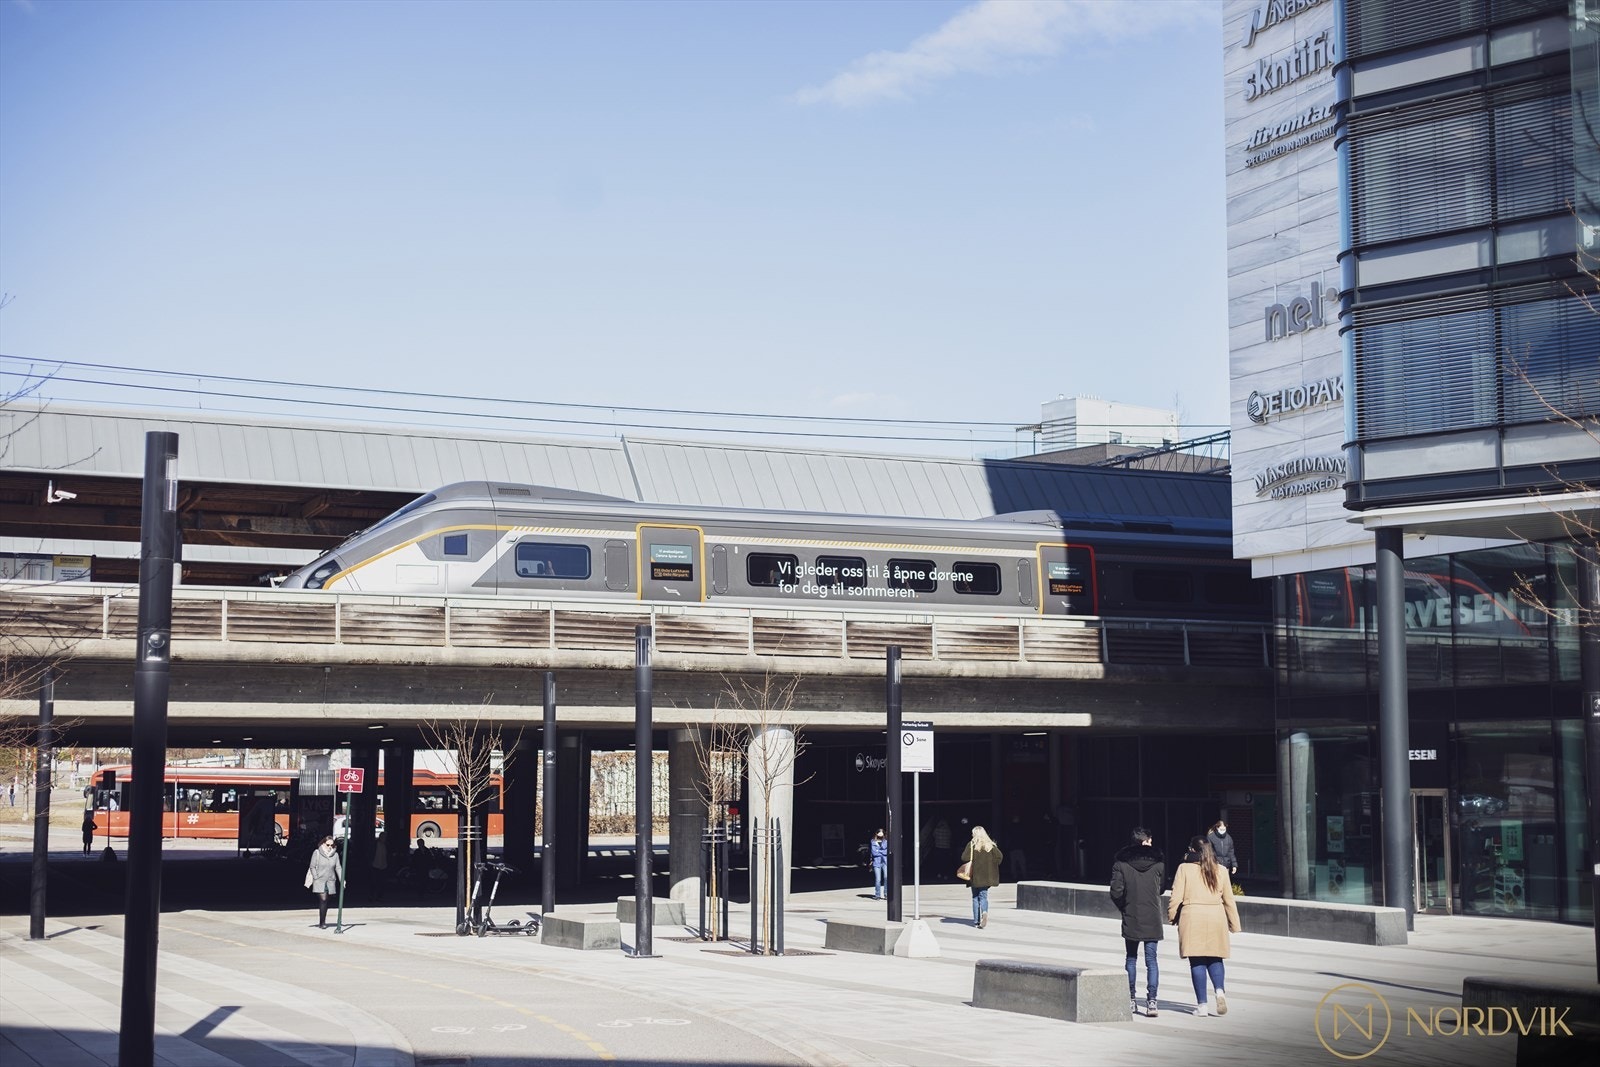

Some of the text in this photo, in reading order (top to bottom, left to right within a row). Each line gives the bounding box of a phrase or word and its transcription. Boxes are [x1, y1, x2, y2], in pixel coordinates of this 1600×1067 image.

[1296, 134, 1310, 149] AIR
[1265, 281, 1322, 341] nel
[1268, 376, 1345, 415] ELOPAK
[1270, 478, 1332, 500] MATMARKED
[777, 561, 974, 583] Vi gleder oss til å åpne dørene
[778, 580, 798, 593] for
[802, 581, 828, 598] deg
[831, 582, 844, 595] til
[865, 755, 888, 771] Skøye
